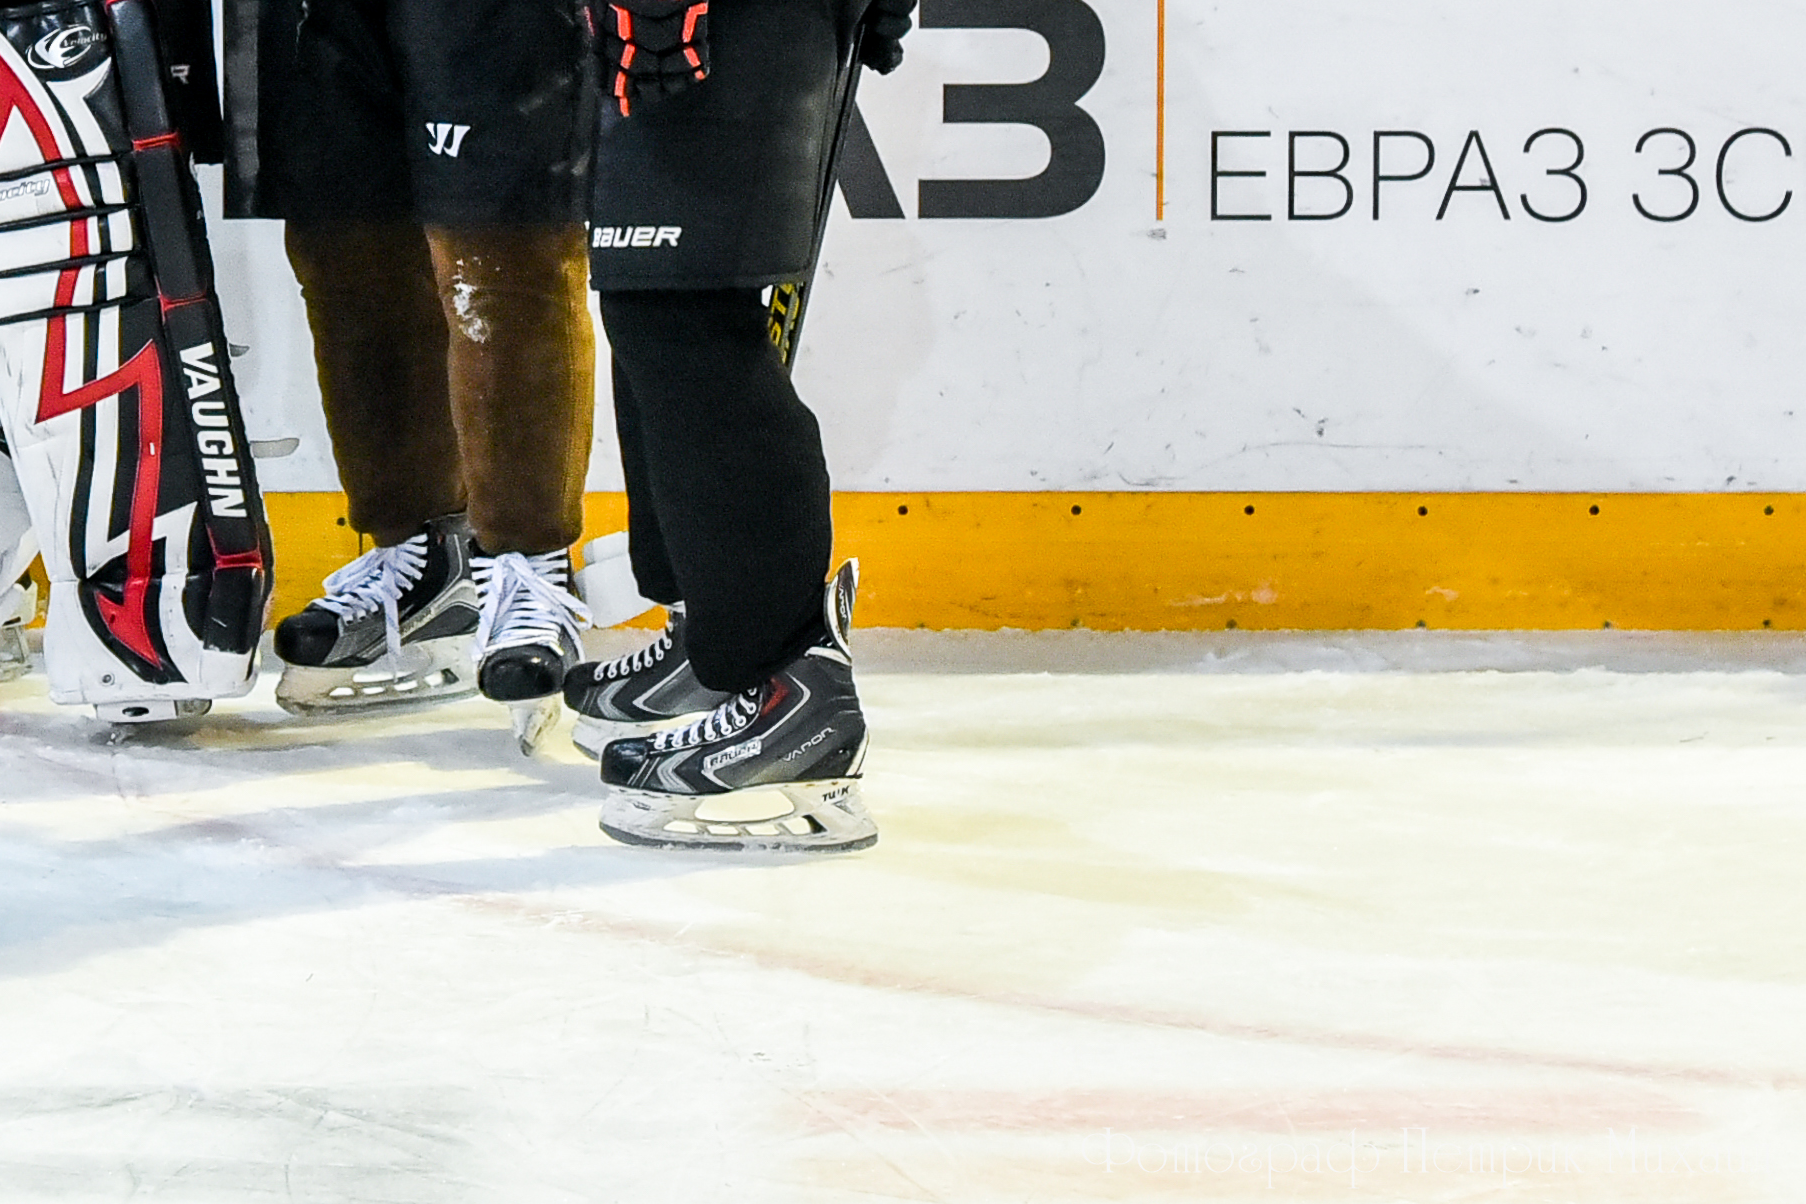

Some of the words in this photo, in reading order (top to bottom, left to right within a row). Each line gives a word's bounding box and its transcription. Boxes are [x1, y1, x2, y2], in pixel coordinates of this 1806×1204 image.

[1210, 127, 1588, 223] ЕВРАЗ
[179, 341, 248, 518] VAUGHN
[782, 726, 837, 763] VAPOR
